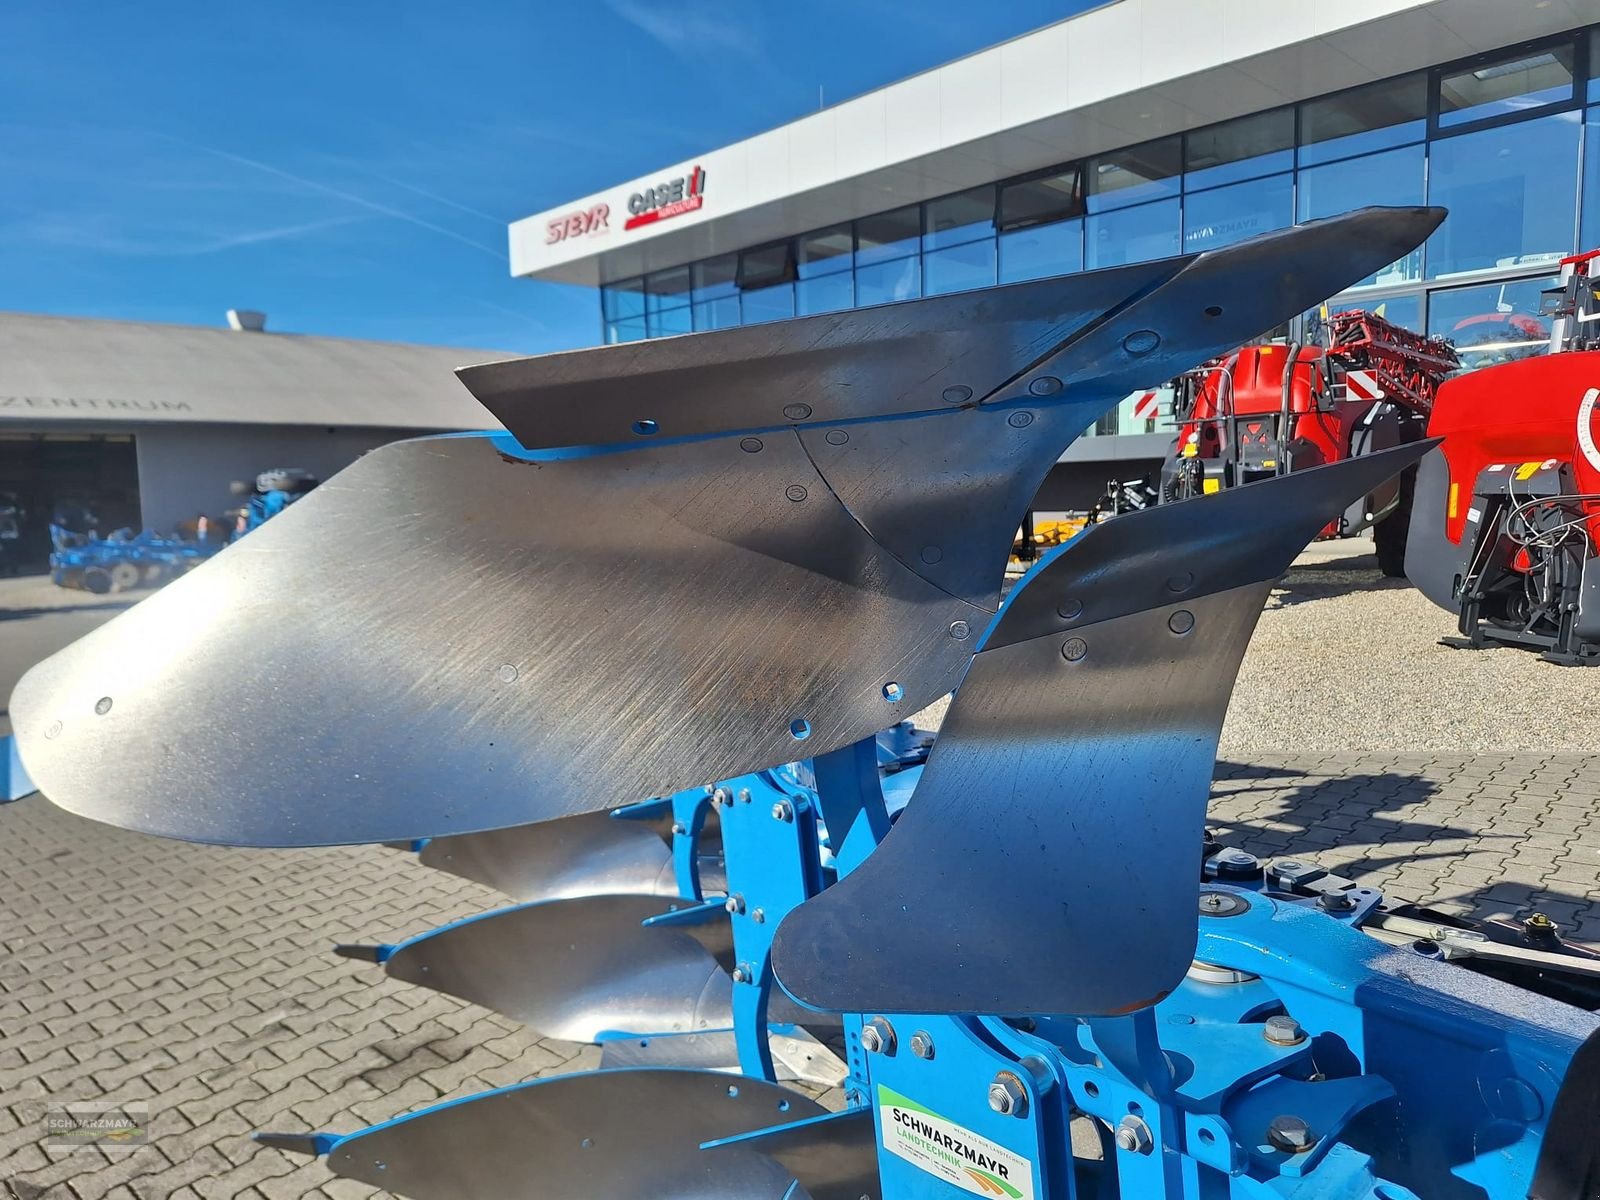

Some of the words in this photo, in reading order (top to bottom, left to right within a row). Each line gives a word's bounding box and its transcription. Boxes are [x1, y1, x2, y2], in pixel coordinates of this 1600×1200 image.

[627, 178, 685, 215] CASE
[546, 203, 610, 245] STEYR
[892, 1108, 1009, 1180] SCHWARZMAYR
[896, 1126, 961, 1169] LANDTECHNIK
